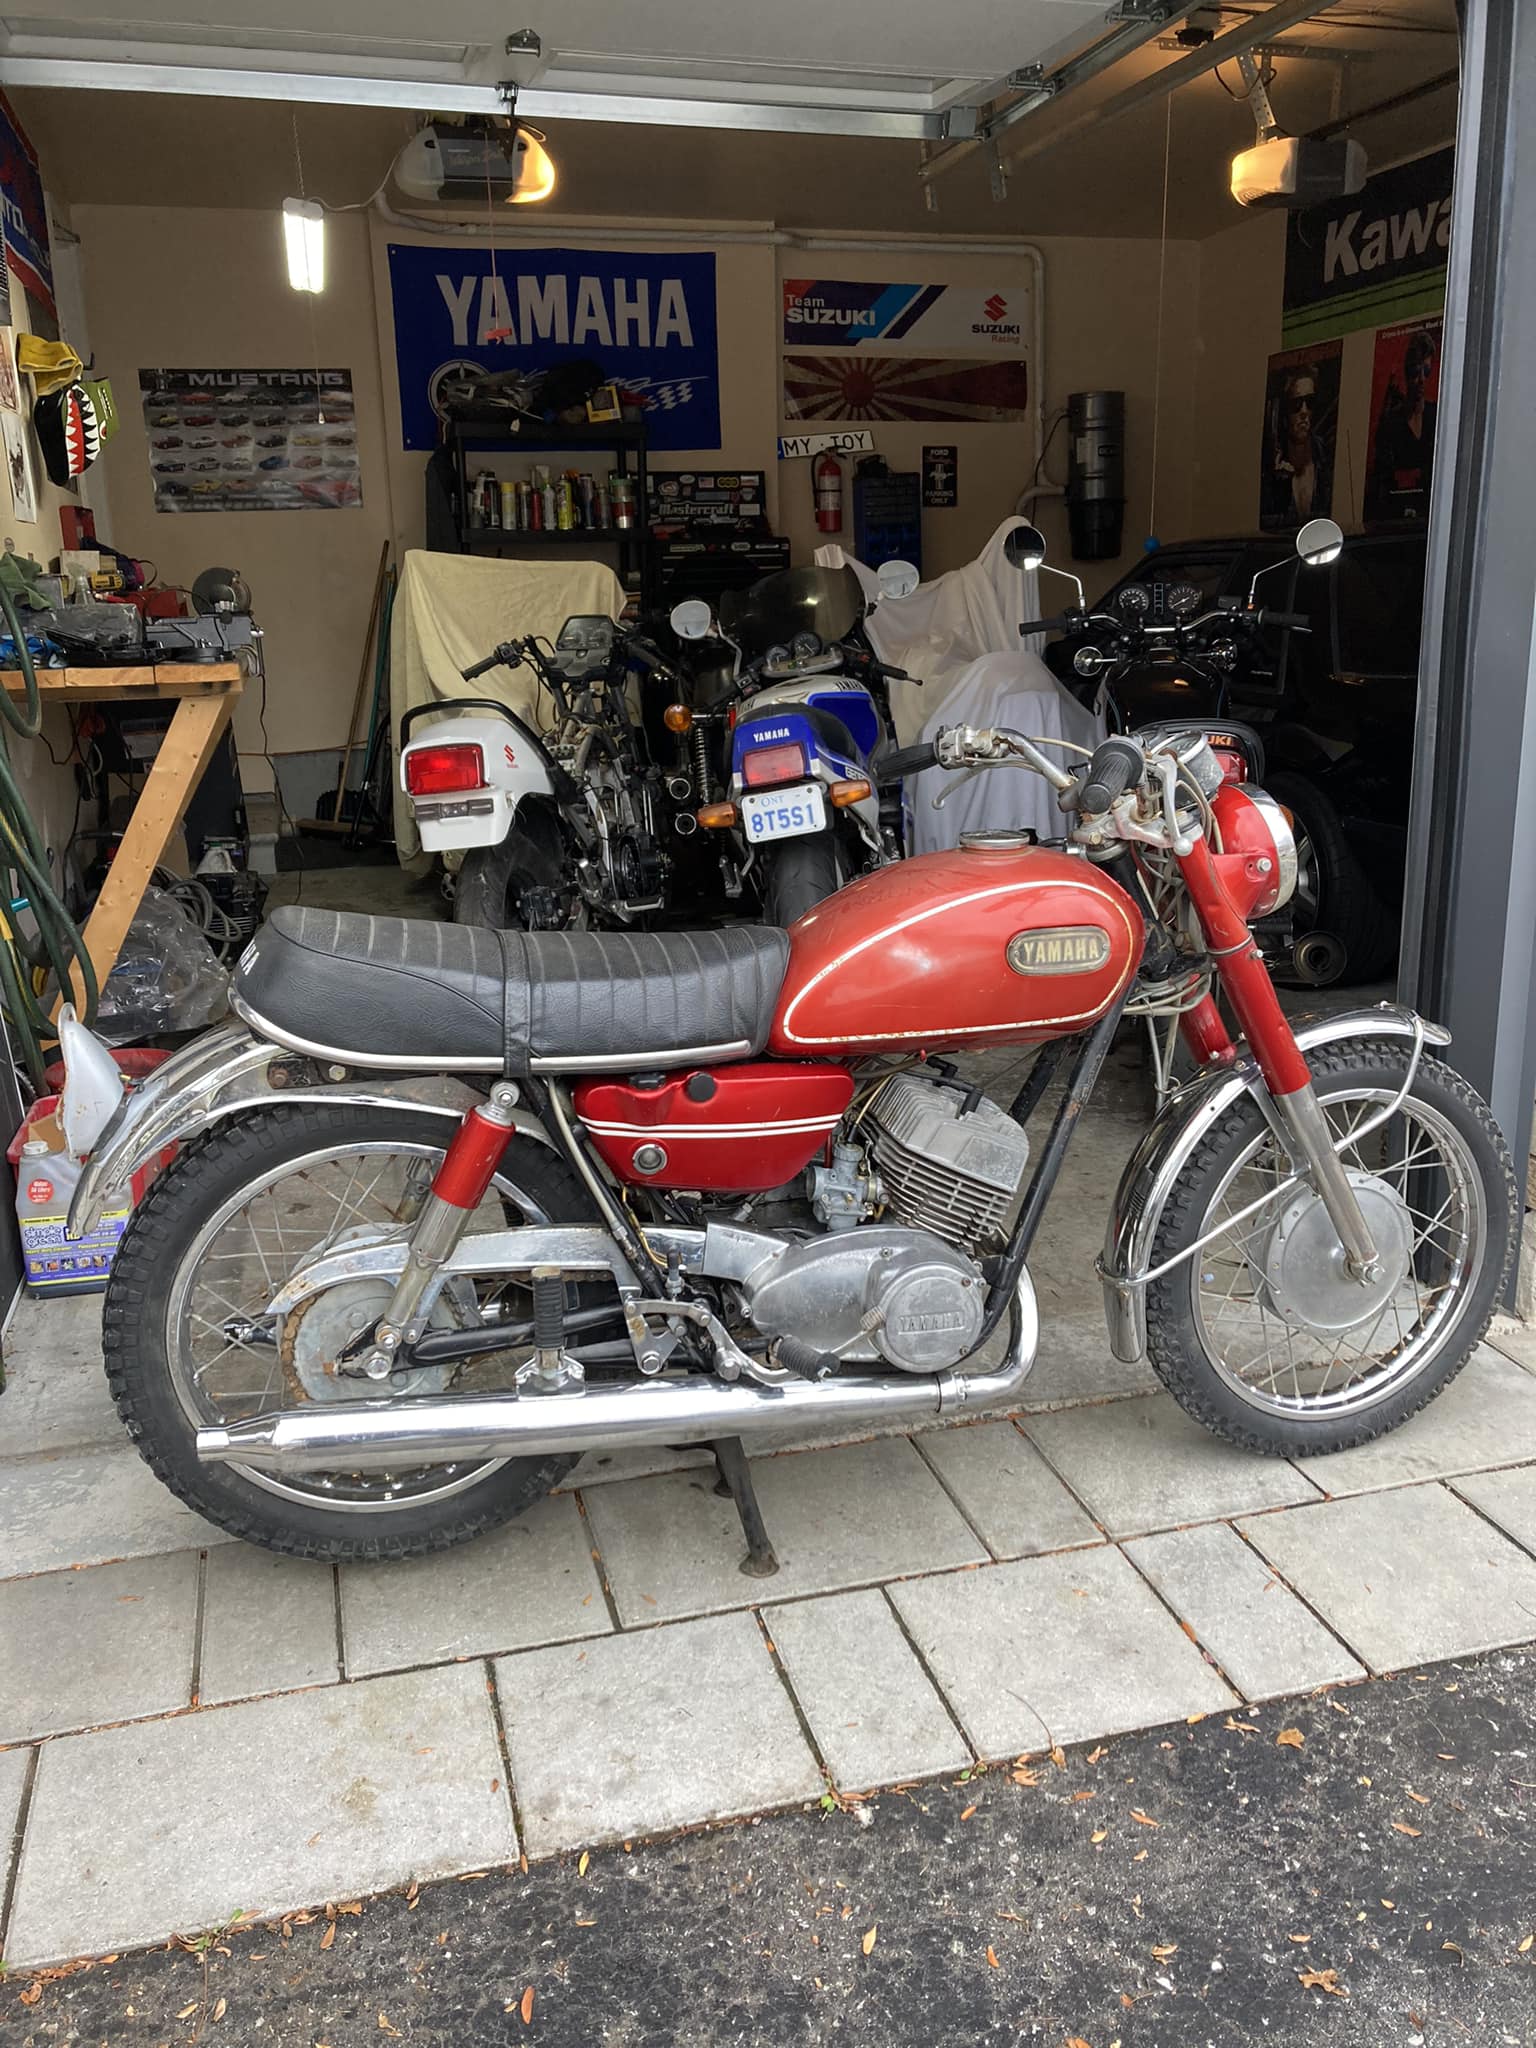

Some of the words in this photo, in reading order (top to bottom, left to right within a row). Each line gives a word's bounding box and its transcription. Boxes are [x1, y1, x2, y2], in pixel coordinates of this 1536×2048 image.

[786, 294, 825, 307] Team
[435, 273, 695, 348] YAMAHA
[786, 308, 876, 326] SUZUKI
[971, 324, 1020, 335] SUZUKI
[991, 334, 1020, 345] Racing
[188, 373, 344, 387] MUSTANG
[783, 438, 811, 455] MY
[659, 502, 735, 516] Mastercraft
[753, 727, 790, 743] YAMAHA
[1207, 735, 1232, 746] UKI
[751, 803, 815, 833] 8T5S1
[1023, 939, 1099, 964] YAMAHA
[24, 1225, 62, 1239] simple
[26, 1234, 63, 1248] green
[899, 1311, 963, 1333] YAMAHA
